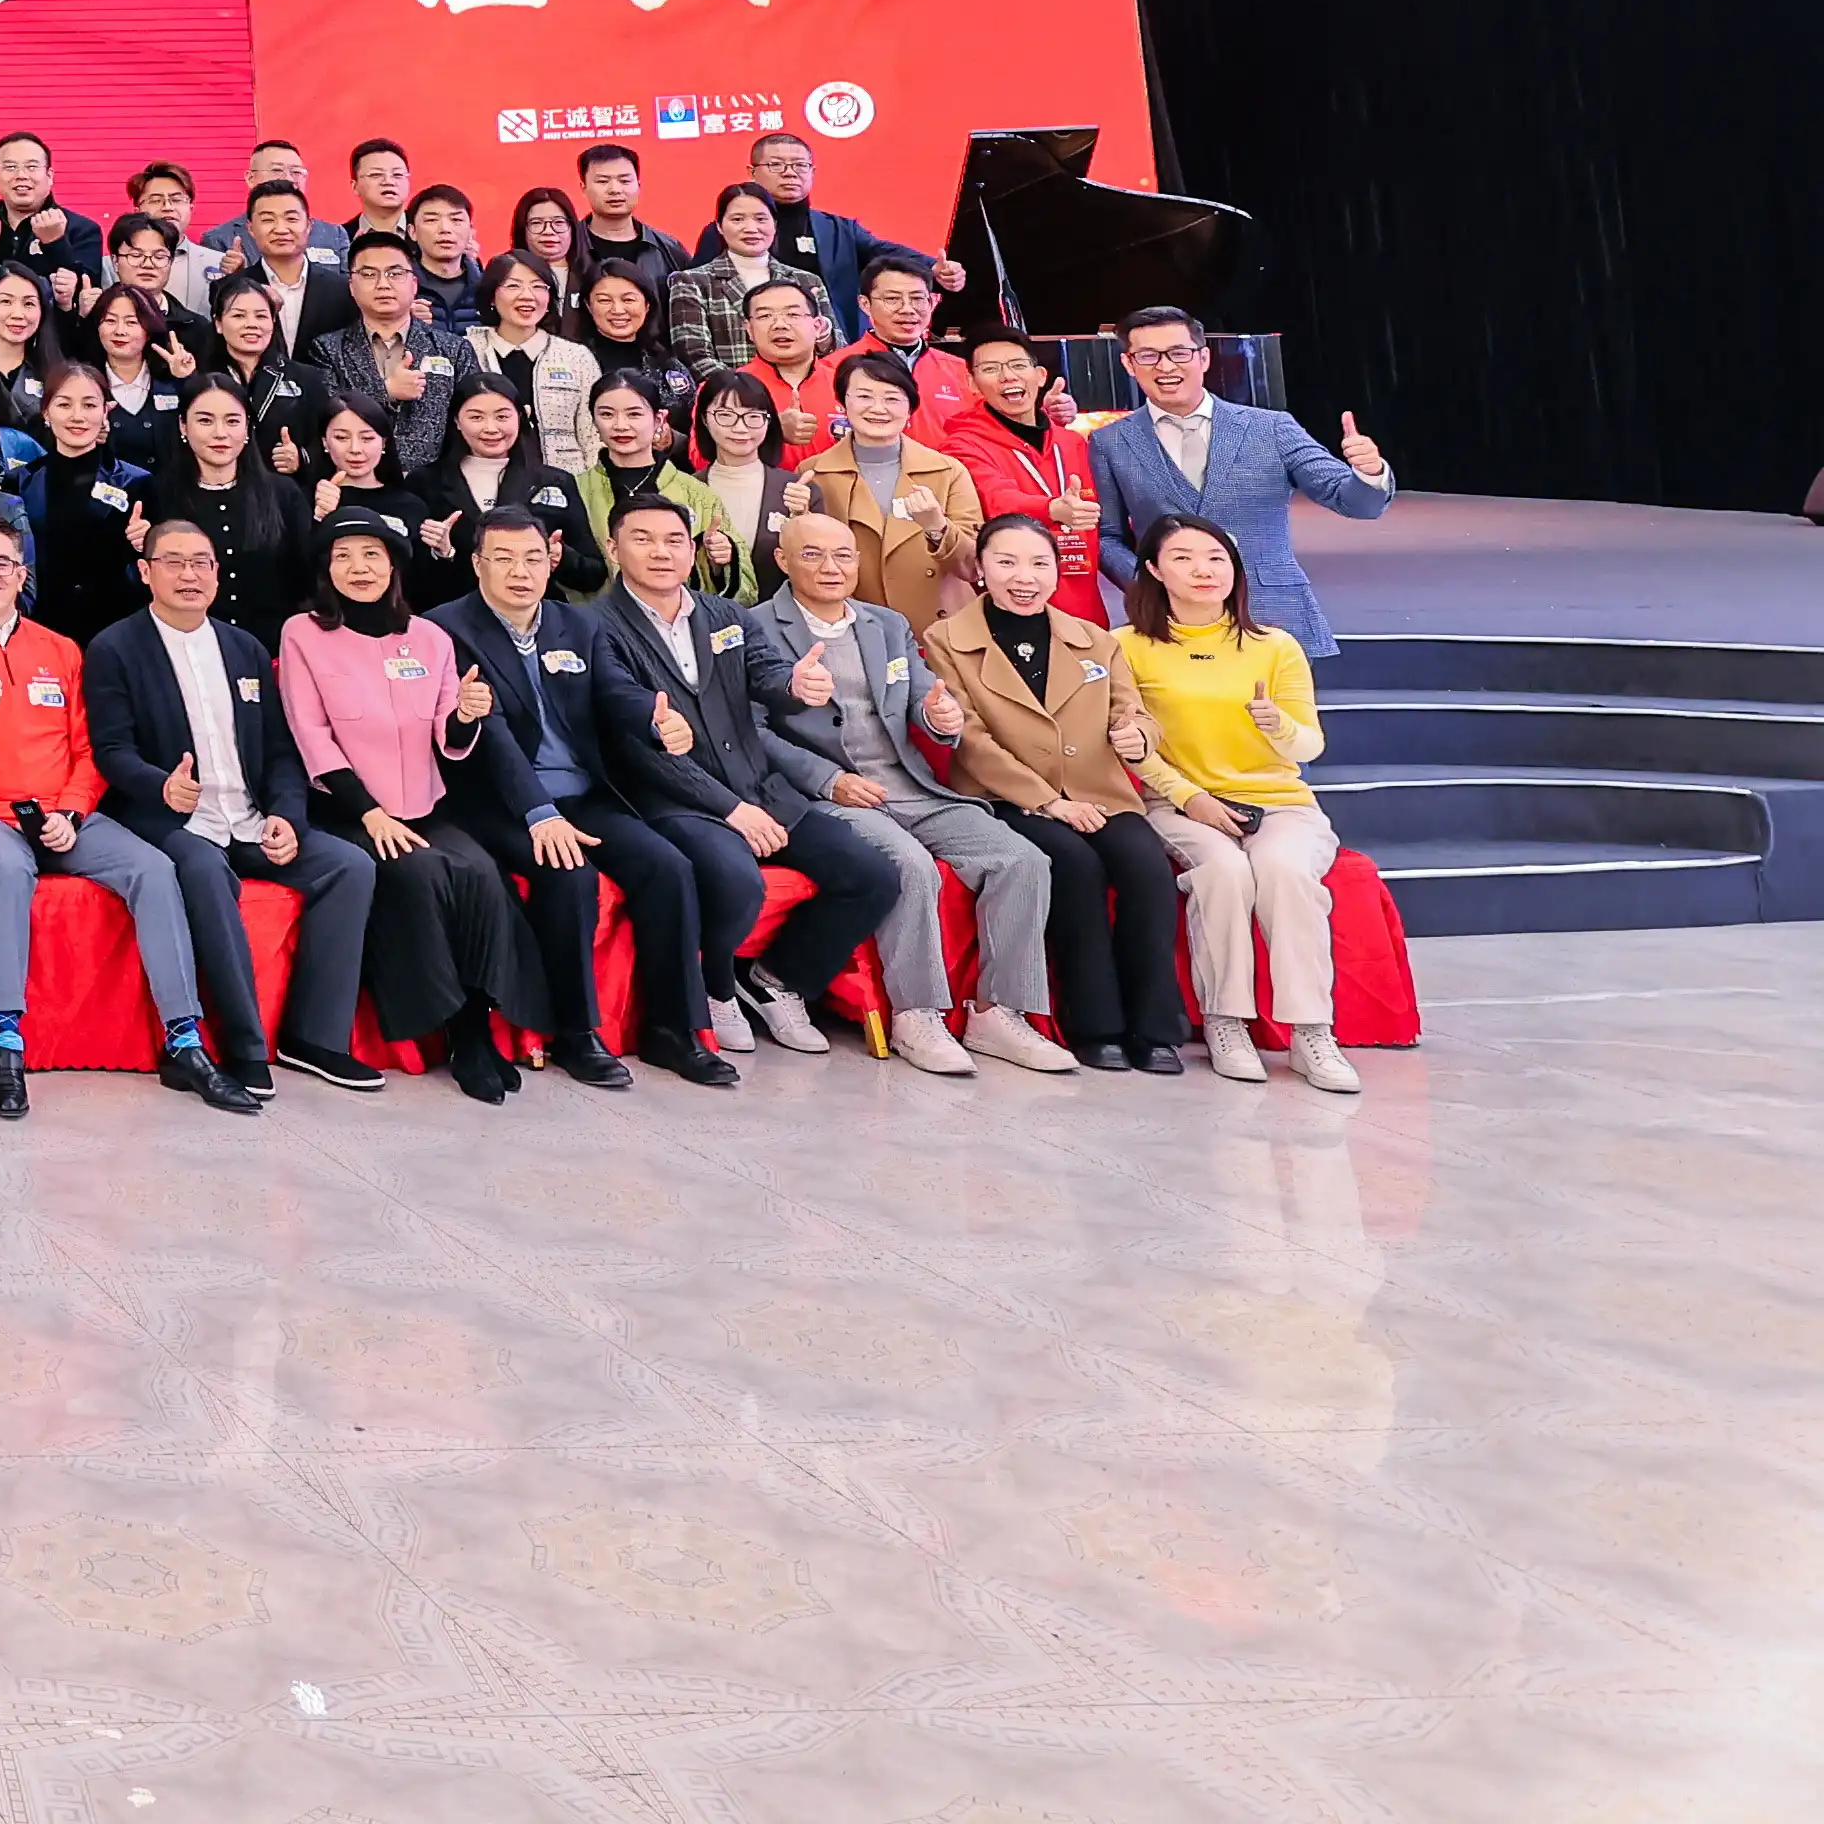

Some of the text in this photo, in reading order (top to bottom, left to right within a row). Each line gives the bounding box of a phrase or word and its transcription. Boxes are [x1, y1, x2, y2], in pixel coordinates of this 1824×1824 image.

[542, 104, 640, 129] 汇诚智远
[1060, 554, 1085, 562] 工作证
